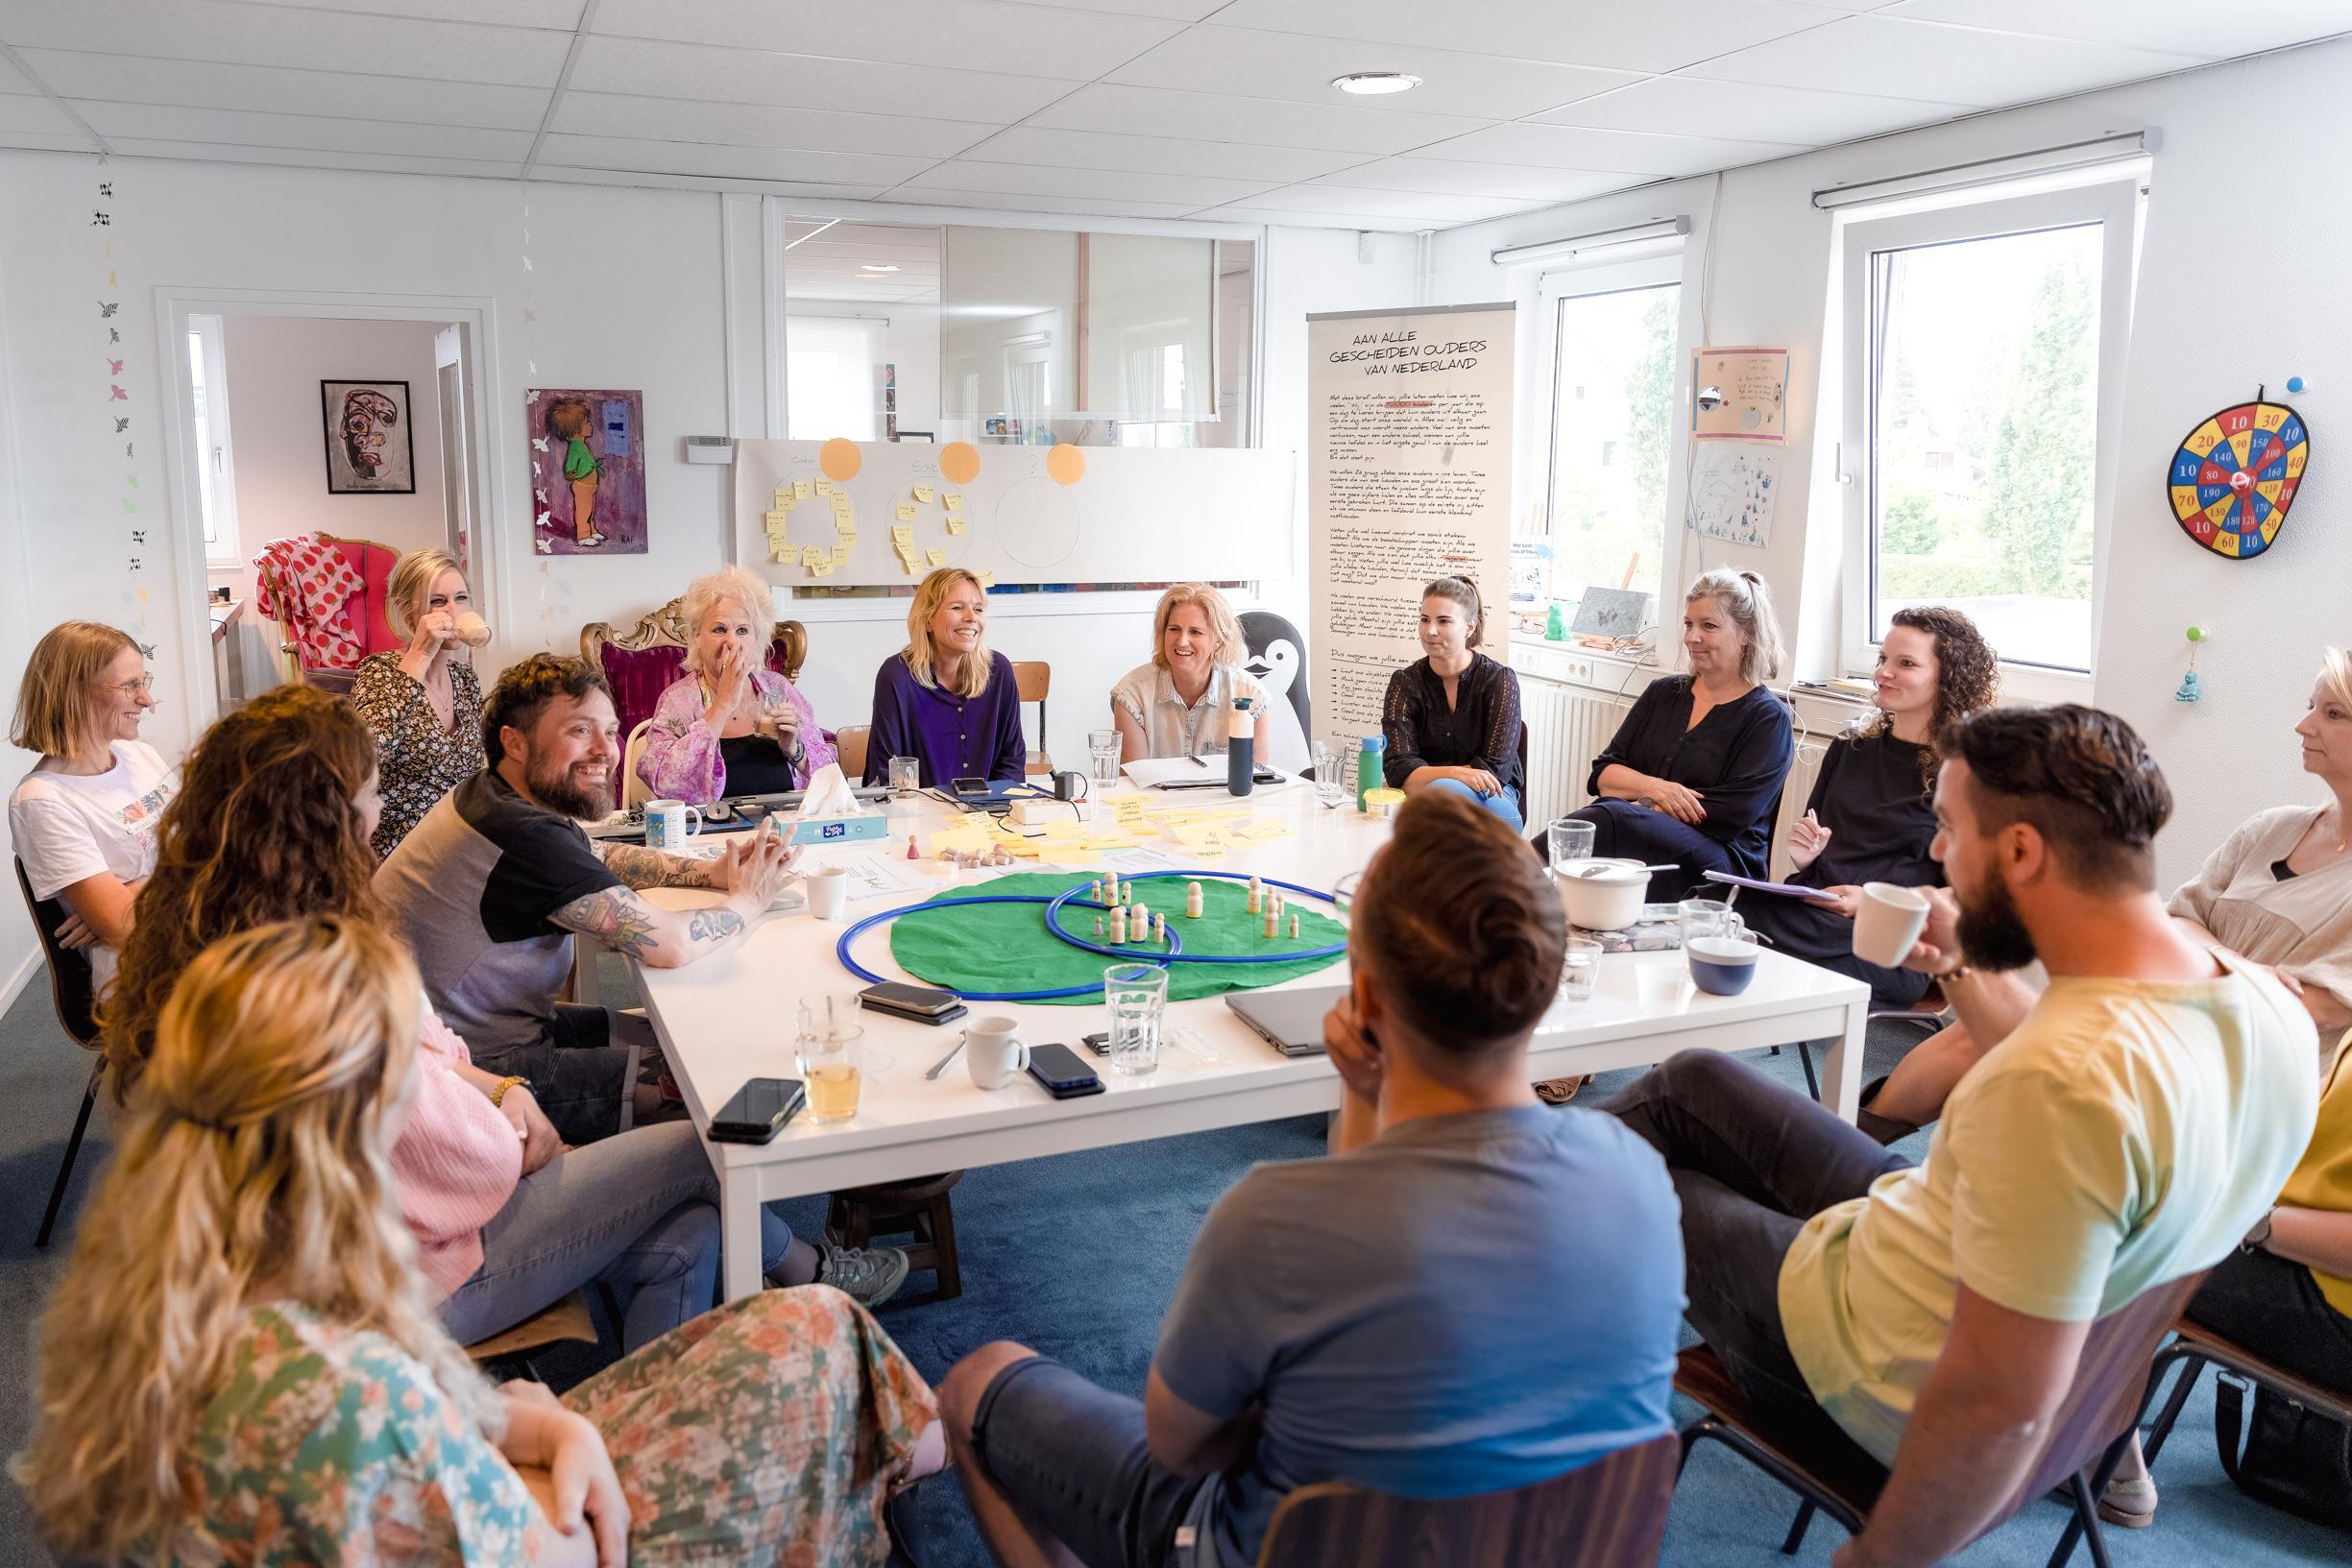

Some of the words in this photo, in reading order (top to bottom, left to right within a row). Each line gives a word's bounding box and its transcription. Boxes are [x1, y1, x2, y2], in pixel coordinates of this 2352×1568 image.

[1353, 334, 1377, 345] AAN
[1381, 331, 1417, 343] ALLE
[1330, 345, 1420, 362] GESCHEIDEN
[1424, 340, 1486, 355] OUDERS
[1365, 365, 1388, 375] VAN
[1392, 358, 1477, 373] NEDERLAND
[2231, 416, 2247, 429] 10
[2262, 414, 2279, 427] 30
[2284, 427, 2299, 441] 10
[2197, 436, 2214, 448] 20
[2236, 439, 2247, 449] 90
[2252, 438, 2268, 448] 150
[2215, 452, 2231, 461] 140
[2266, 449, 2280, 459] 100
[2289, 457, 2303, 469] 40
[2180, 465, 2196, 477] 10
[2206, 470, 2218, 479] 80
[2268, 467, 2281, 477] 160
[2204, 489, 2220, 498] 190
[2265, 484, 2278, 494] 110
[2280, 488, 2292, 501] 10
[2179, 495, 2194, 507] 70
[2210, 508, 2225, 517] 130
[2257, 504, 2268, 513] 170
[2227, 517, 2240, 526] 180
[2243, 516, 2255, 525] 120
[2266, 519, 2276, 531] 50
[2195, 522, 2210, 533] 10
[2222, 536, 2234, 547] 60
[2246, 536, 2257, 547] 10
[1331, 649, 1344, 657] Dus
